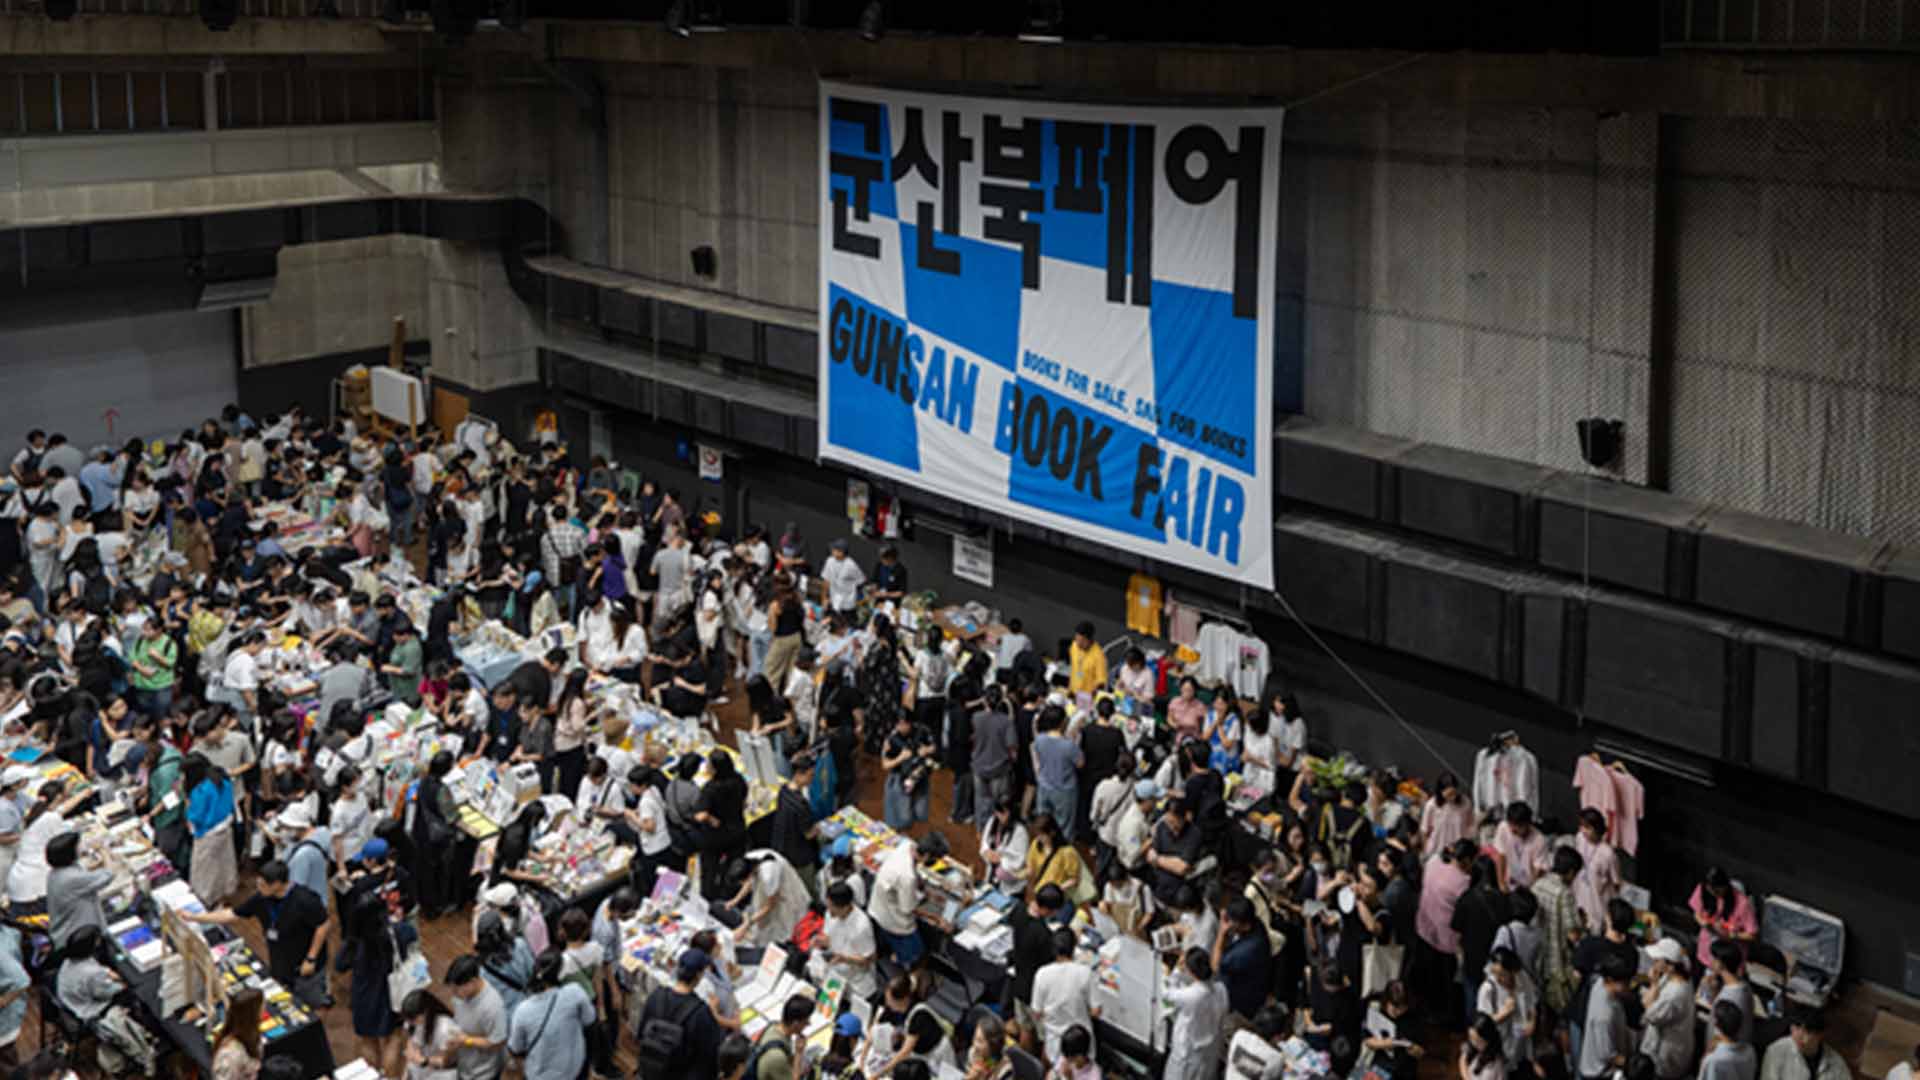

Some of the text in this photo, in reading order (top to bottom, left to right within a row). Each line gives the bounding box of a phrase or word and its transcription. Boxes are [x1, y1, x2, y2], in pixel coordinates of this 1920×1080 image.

[829, 97, 1265, 320] 군산북페어
[829, 297, 1245, 567] GUNSAN BOOK FAIR
[1022, 349, 1061, 382] BOOKS
[1064, 367, 1089, 395] FOR
[1168, 411, 1196, 439] FOR
[1201, 423, 1247, 458] BOOKS
